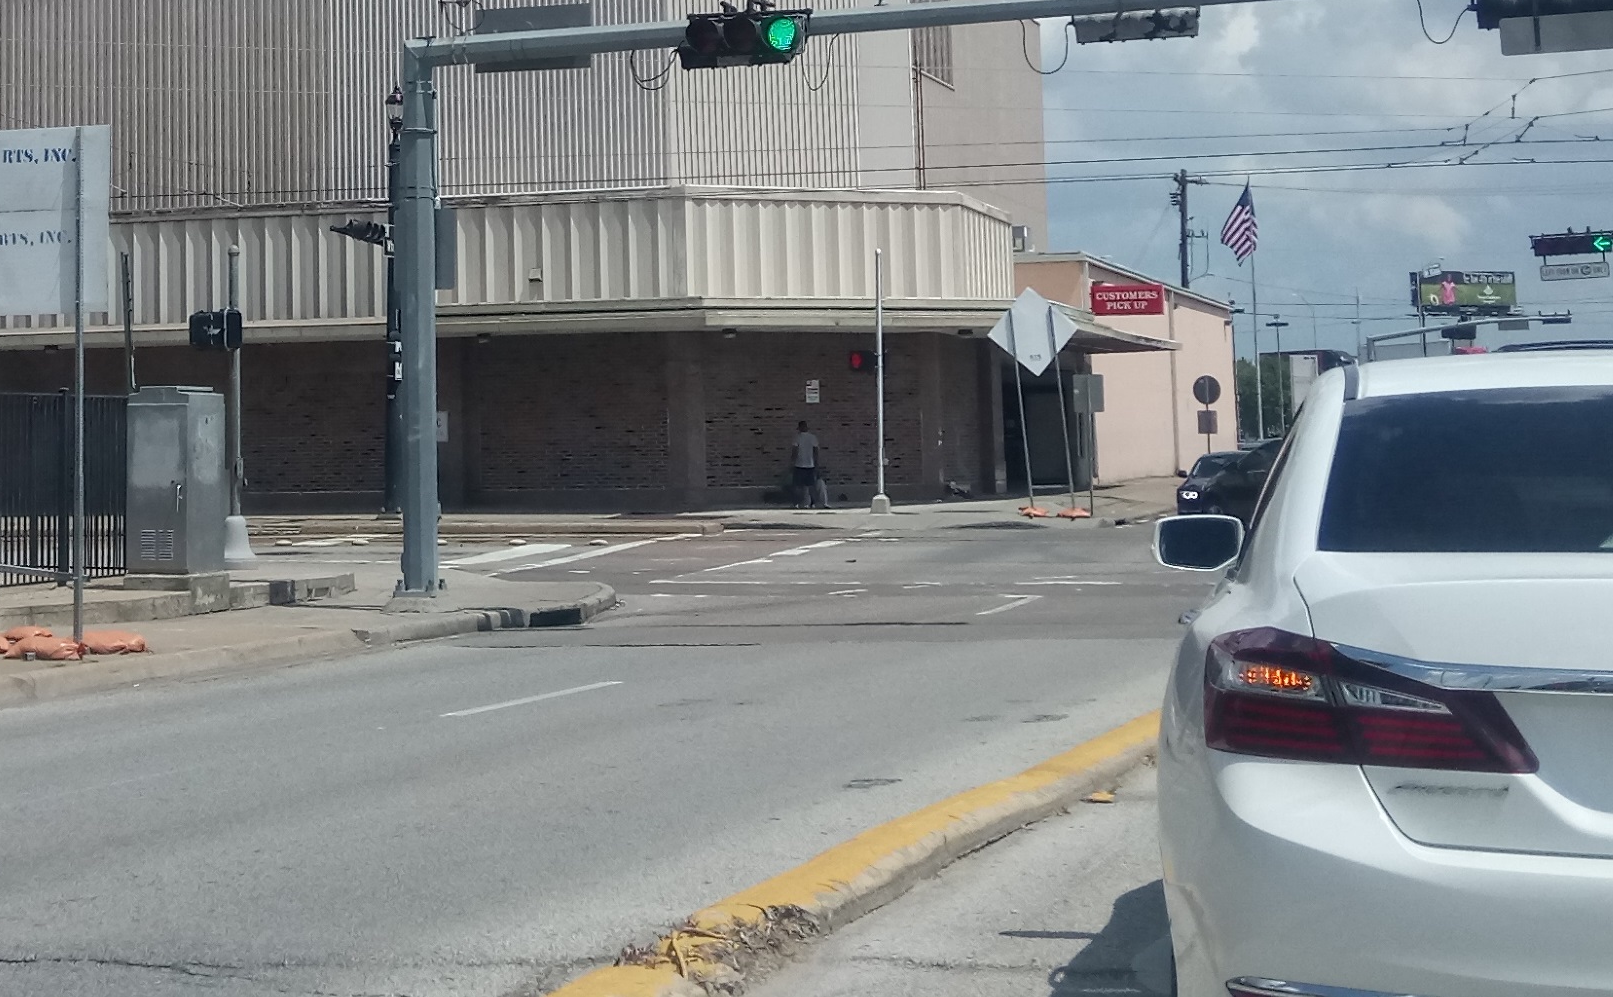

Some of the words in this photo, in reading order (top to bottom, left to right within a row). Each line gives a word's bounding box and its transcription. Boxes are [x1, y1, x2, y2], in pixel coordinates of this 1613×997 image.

[1096, 291, 1158, 300] CUSTOMERS
[1106, 301, 1132, 310] PICK
[1133, 301, 1148, 310] UP
